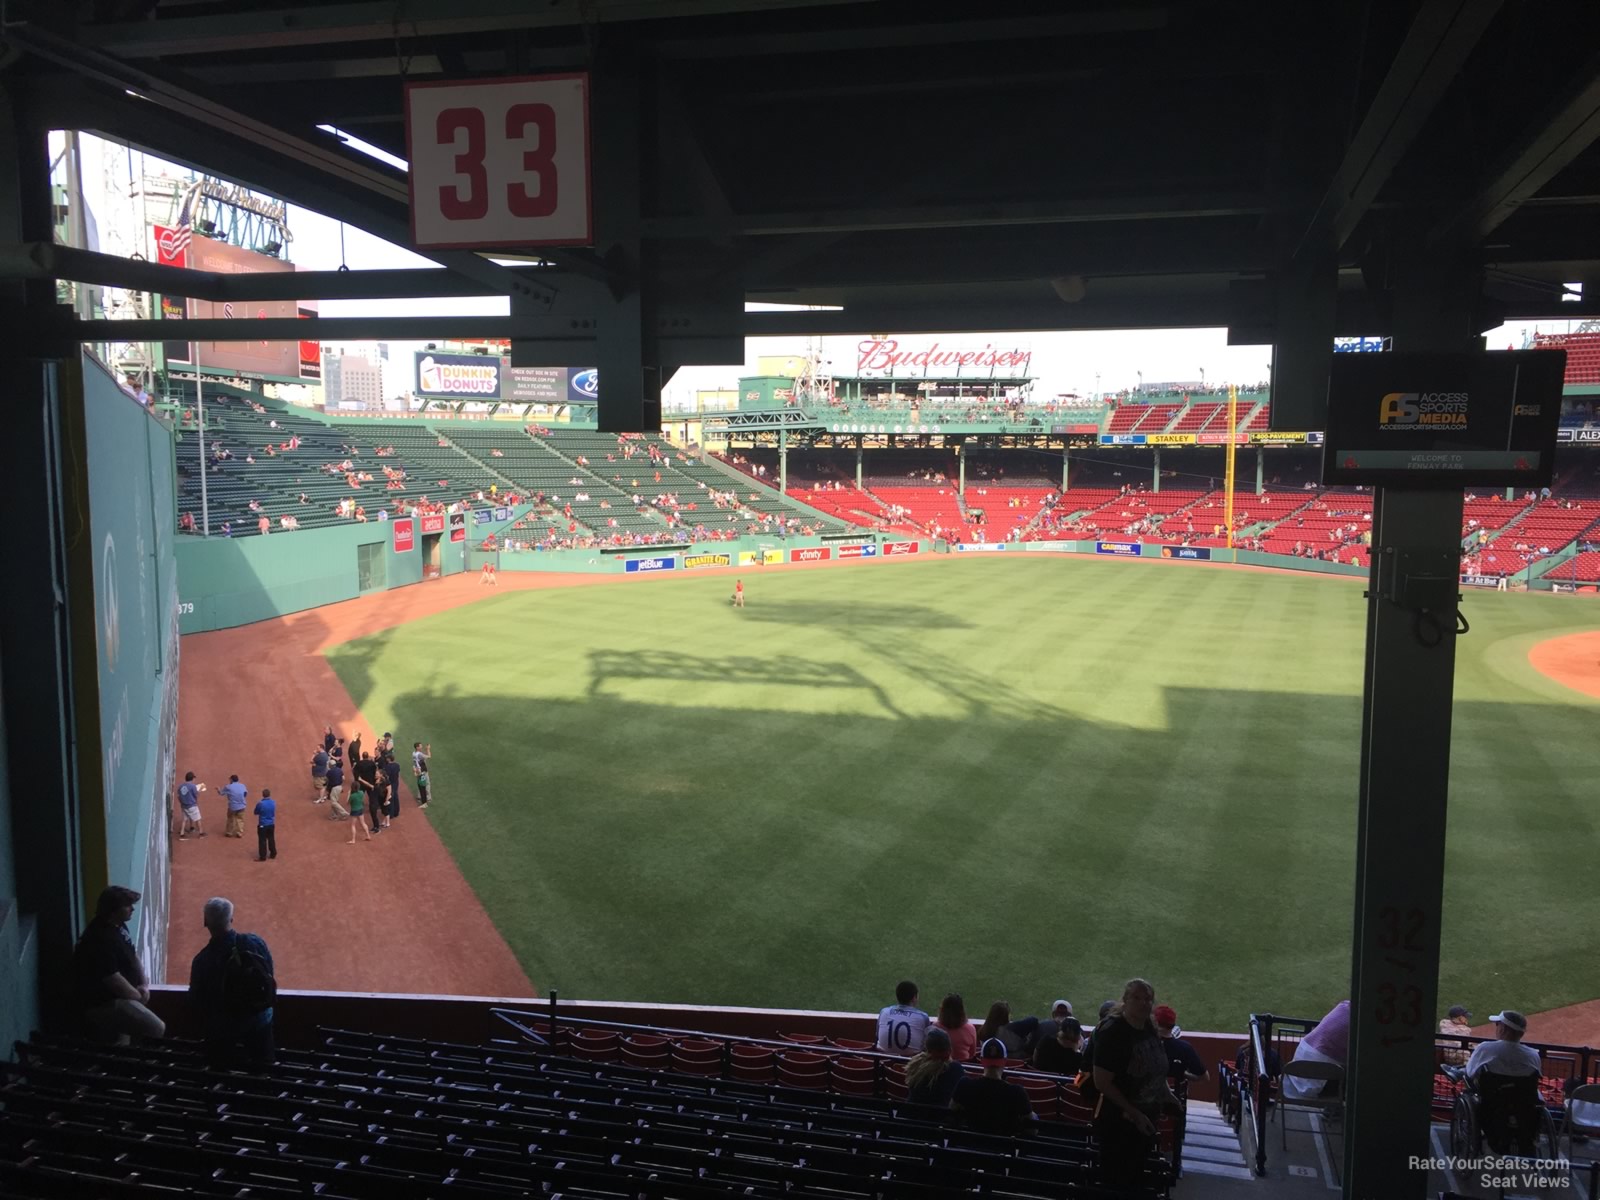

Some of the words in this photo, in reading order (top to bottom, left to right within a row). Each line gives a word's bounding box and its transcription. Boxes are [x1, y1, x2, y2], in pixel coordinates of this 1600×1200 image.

[435, 102, 558, 221] 33
[858, 340, 1032, 370] Budweiser
[443, 368, 495, 379] DUNKIN'
[443, 379, 494, 390] DONUTS
[1420, 392, 1469, 403] ACCESS
[1419, 403, 1468, 413] SPORTS
[1418, 413, 1467, 424] MEDIA
[1155, 434, 1190, 443] STANLEY
[1407, 462, 1441, 470] FENWAY
[1442, 462, 1464, 470] PARK
[800, 549, 822, 560] xfinity
[638, 558, 663, 570] jetBlue
[685, 556, 714, 569] GRANITE
[714, 554, 730, 567] CITY
[1374, 981, 1423, 1026] 33
[886, 1019, 911, 1050] 10
